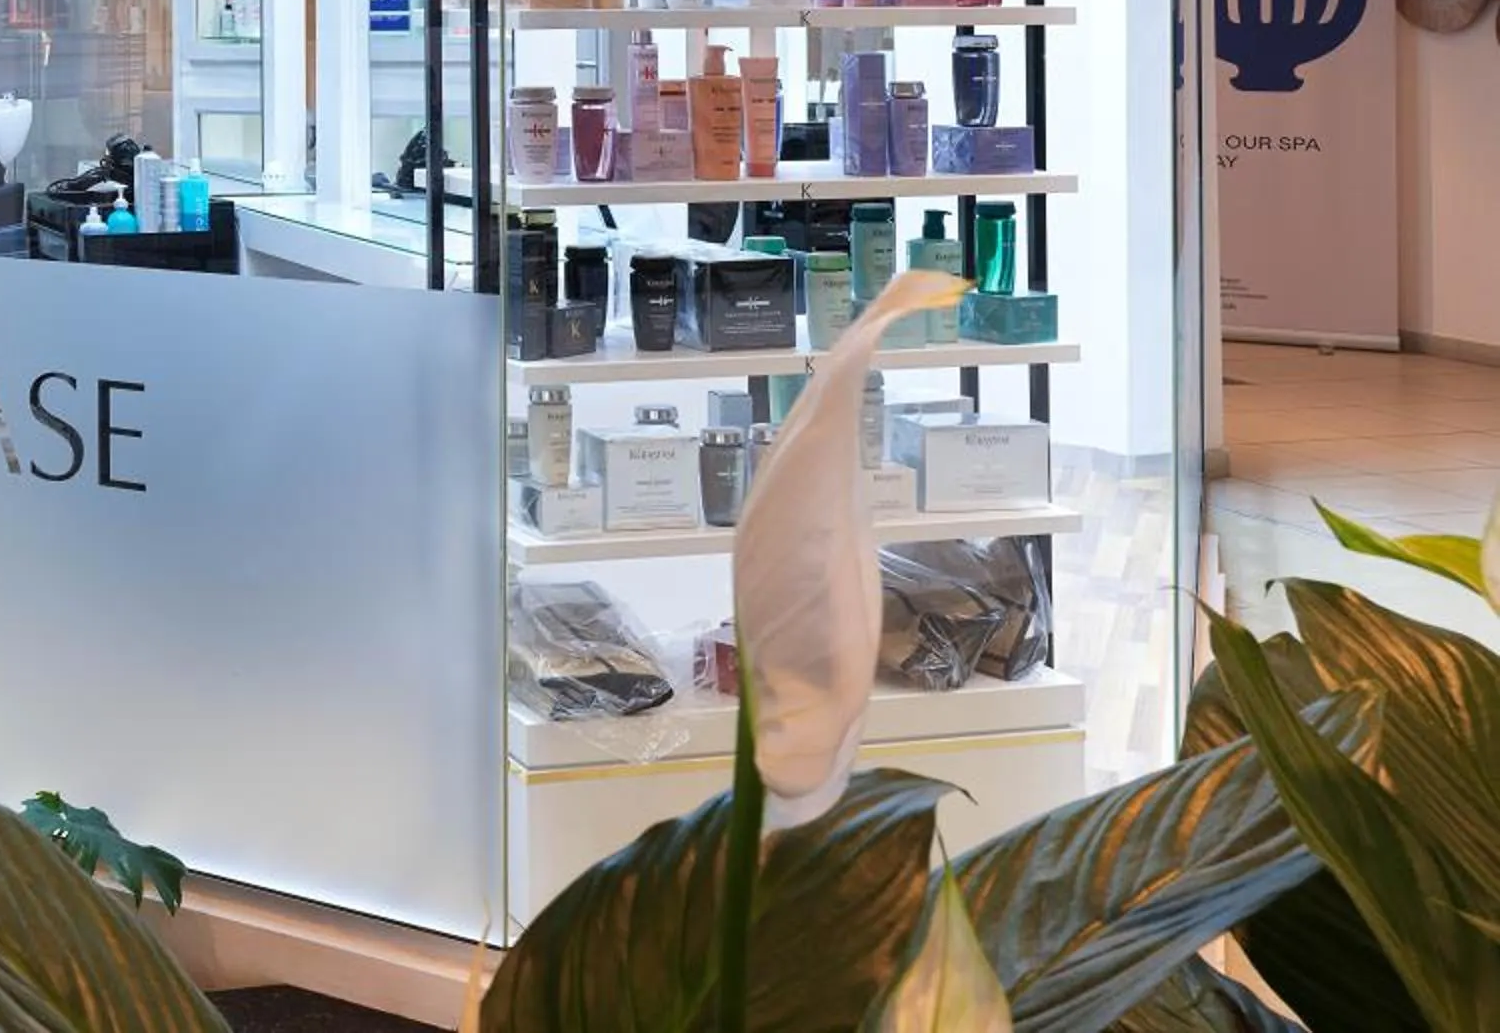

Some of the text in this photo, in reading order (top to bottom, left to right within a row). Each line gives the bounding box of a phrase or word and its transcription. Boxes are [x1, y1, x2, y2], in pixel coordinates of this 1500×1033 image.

[1225, 134, 1321, 152] OUR SPA
[1217, 155, 1237, 168] AY
